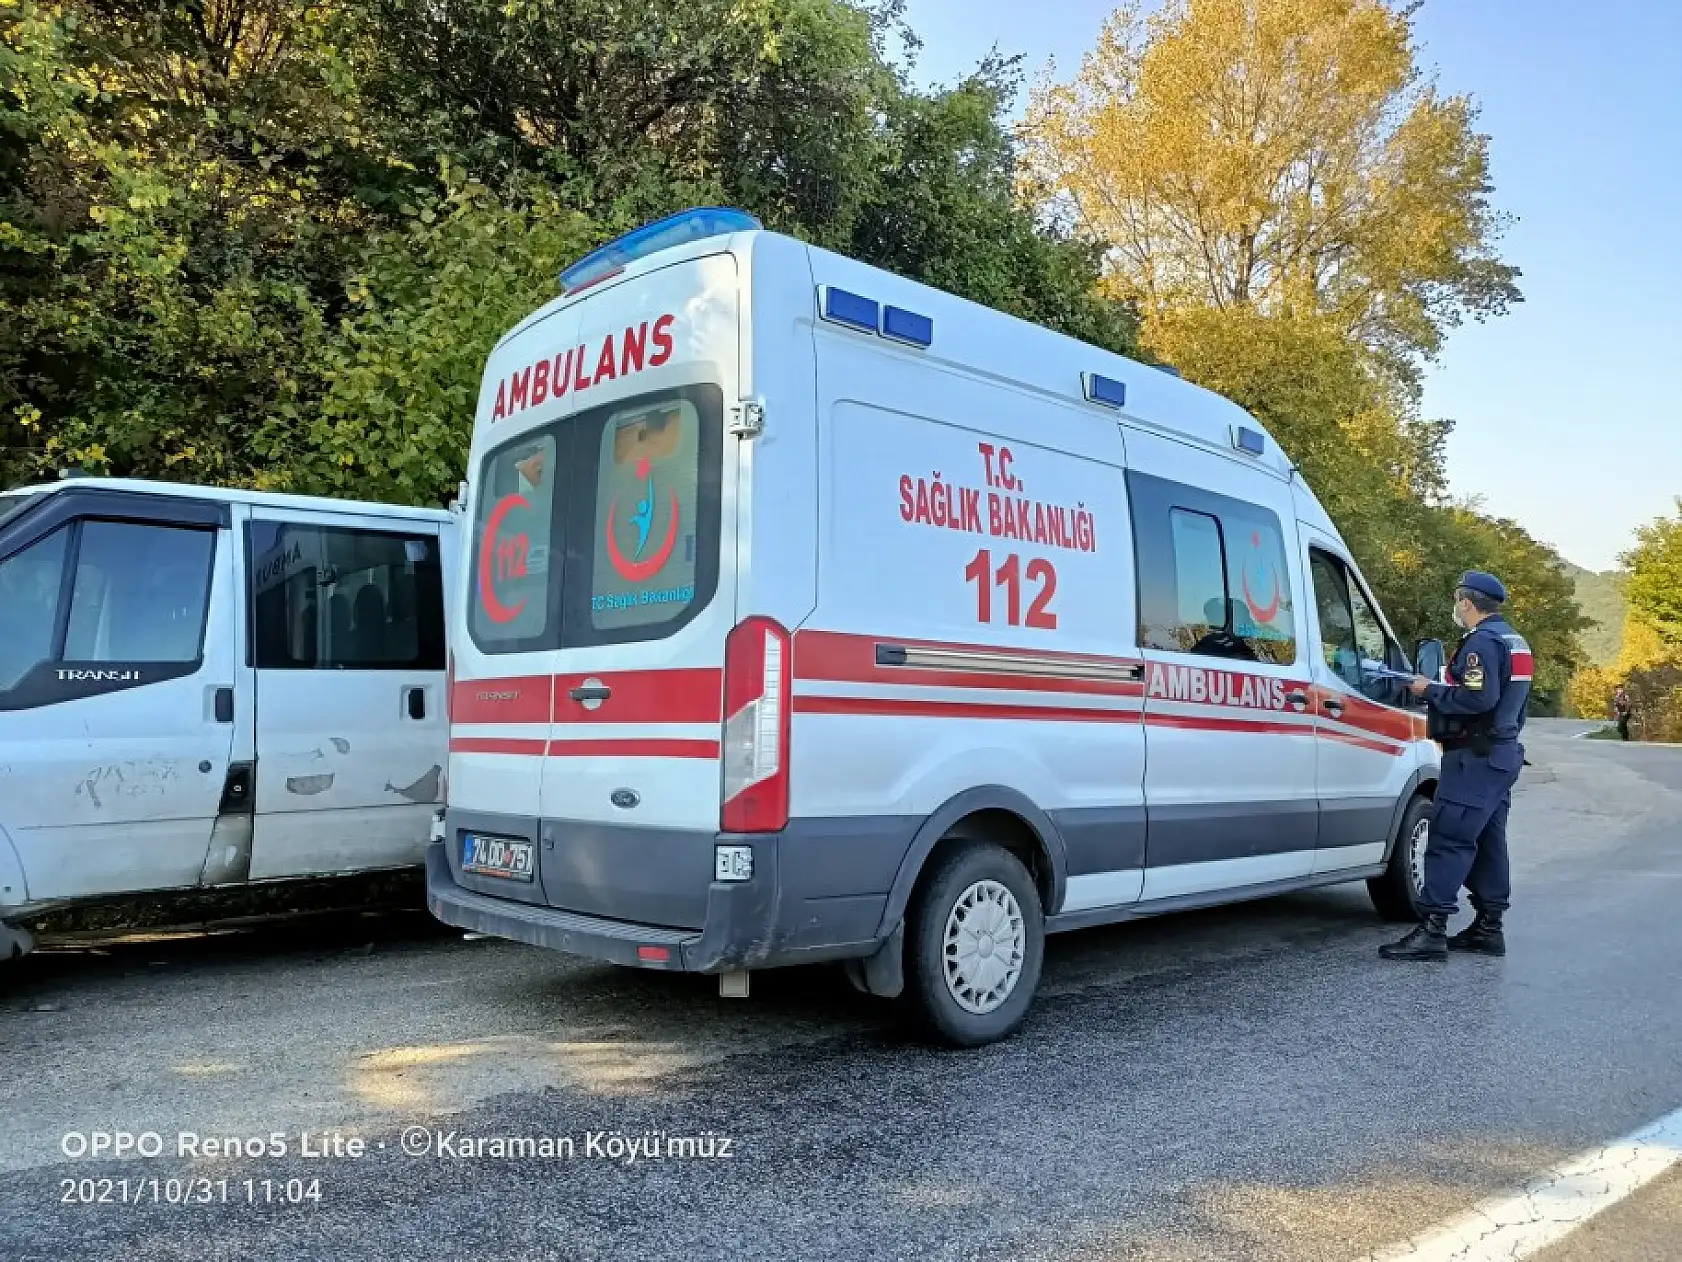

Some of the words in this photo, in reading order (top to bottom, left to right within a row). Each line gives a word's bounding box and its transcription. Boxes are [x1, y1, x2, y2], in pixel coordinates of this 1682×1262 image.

[490, 314, 675, 424] AMBULANS
[979, 442, 1024, 492] T.C.
[900, 470, 984, 534] SAĞLIK
[988, 492, 1096, 552] BAKANLIĞI
[497, 533, 529, 582] 112
[965, 548, 1058, 630] 112
[1149, 663, 1287, 710] AMBULANS
